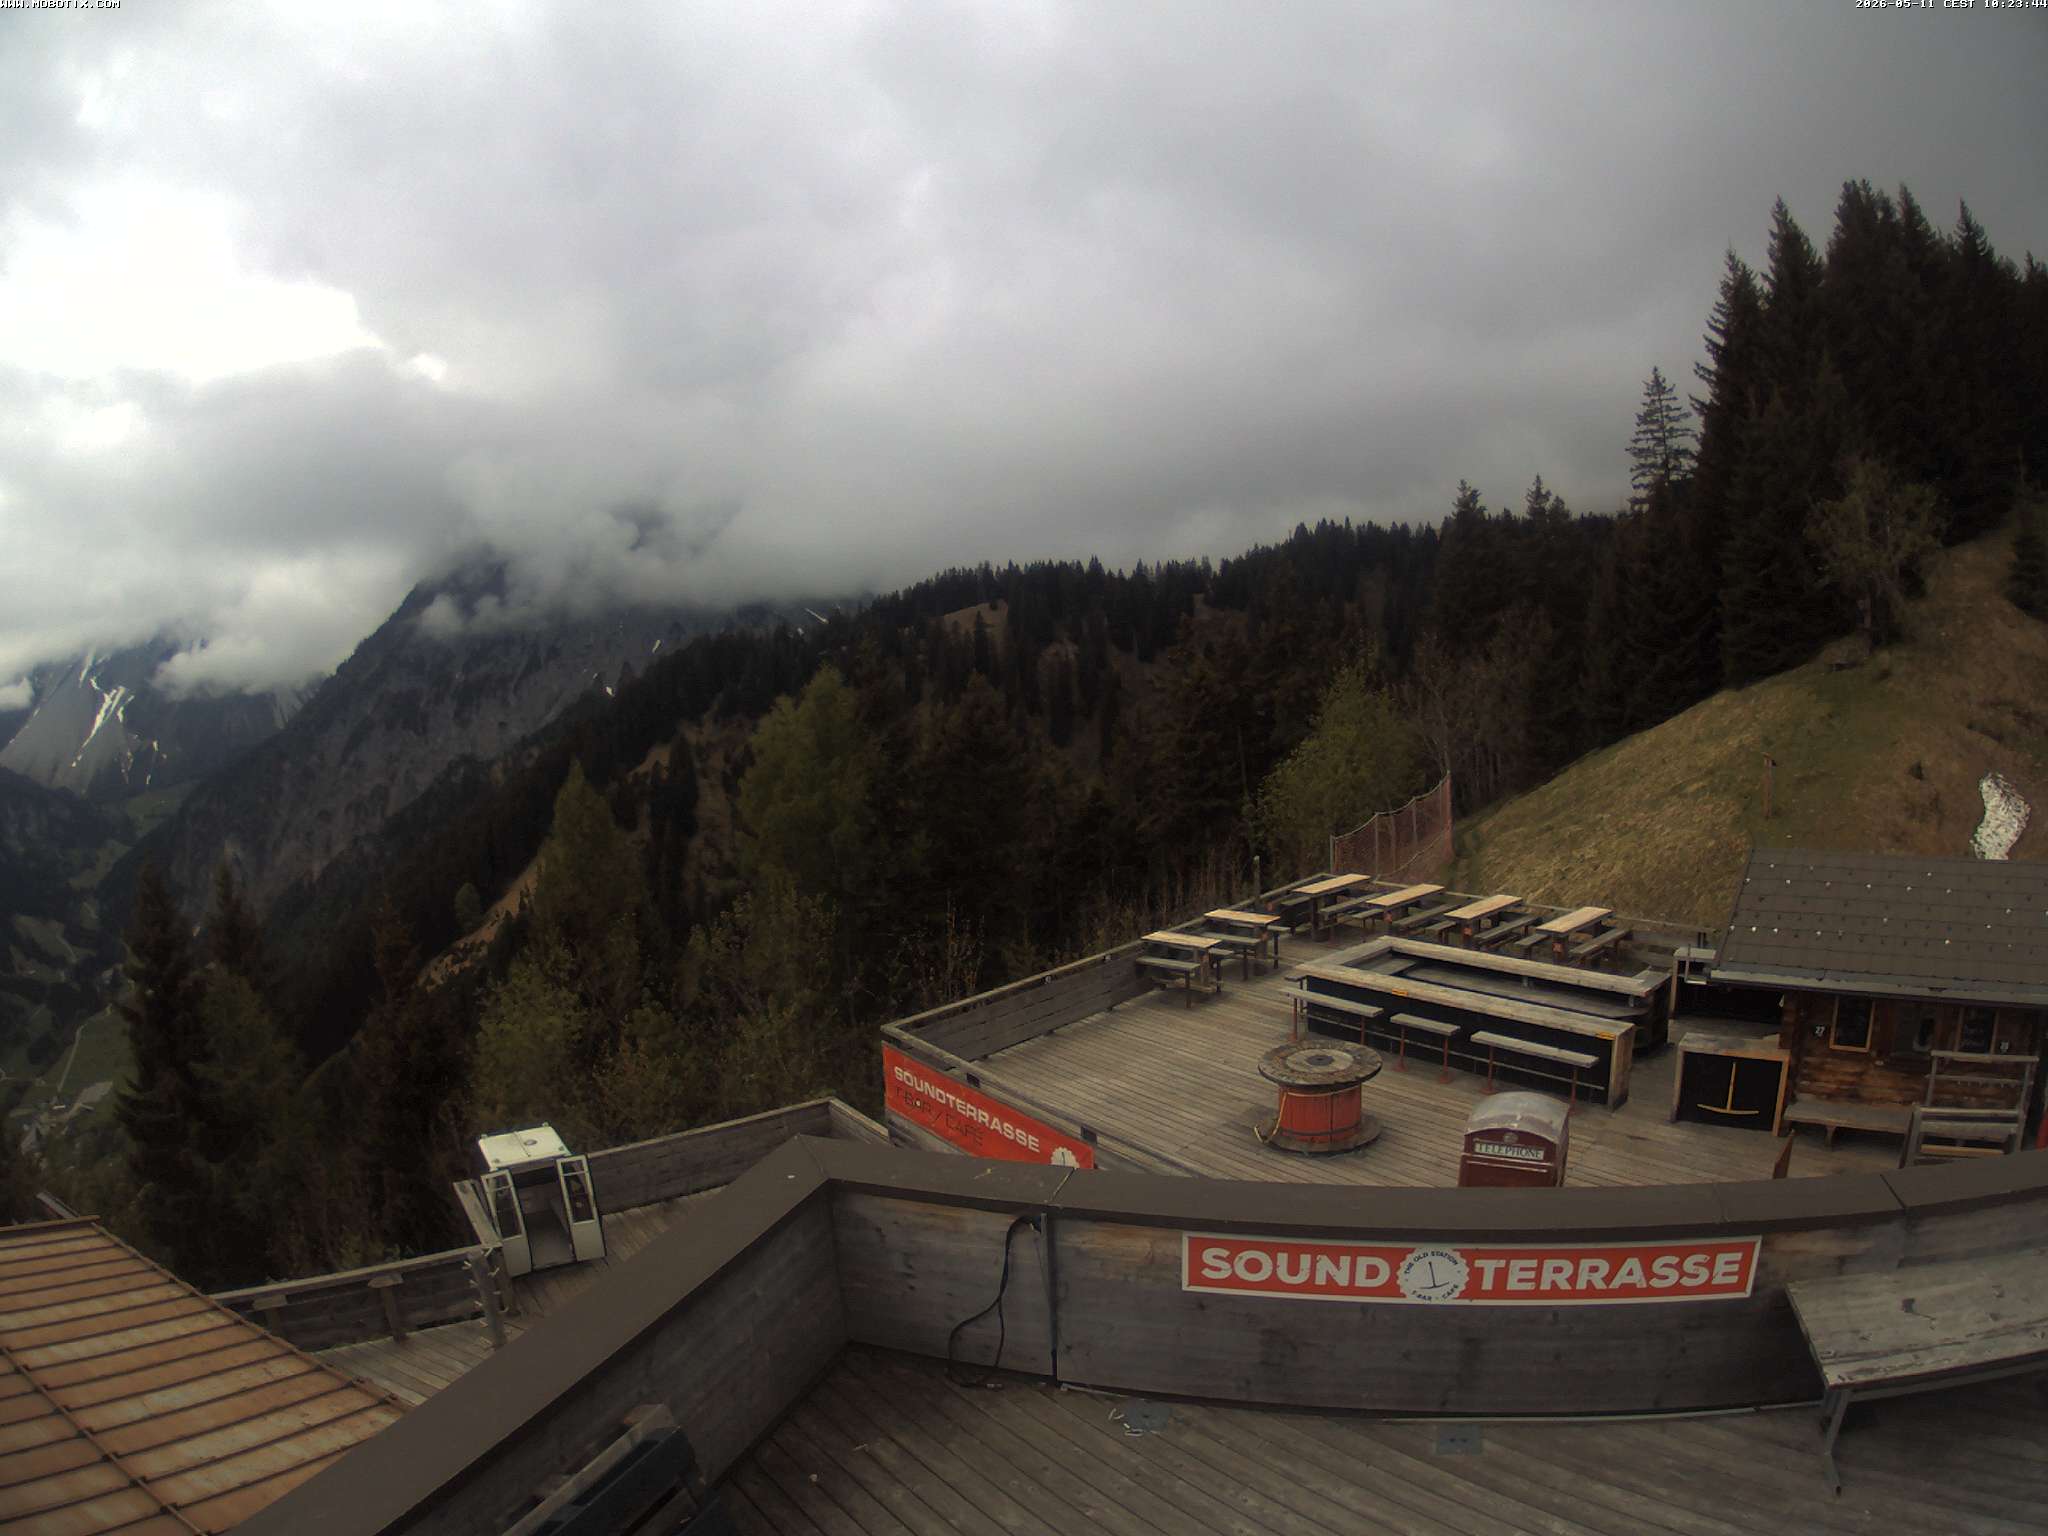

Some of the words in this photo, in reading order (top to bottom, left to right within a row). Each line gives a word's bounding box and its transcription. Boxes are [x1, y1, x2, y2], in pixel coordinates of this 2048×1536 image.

[894, 1066, 1041, 1153] SOUNDTERRASSE
[1477, 1143, 1542, 1159] TELEPHONE
[1201, 1247, 1391, 1287] SOUND
[1413, 1251, 1429, 1262] OLD
[1431, 1250, 1459, 1265] STATION
[1474, 1252, 1743, 1291] TERRASSE
